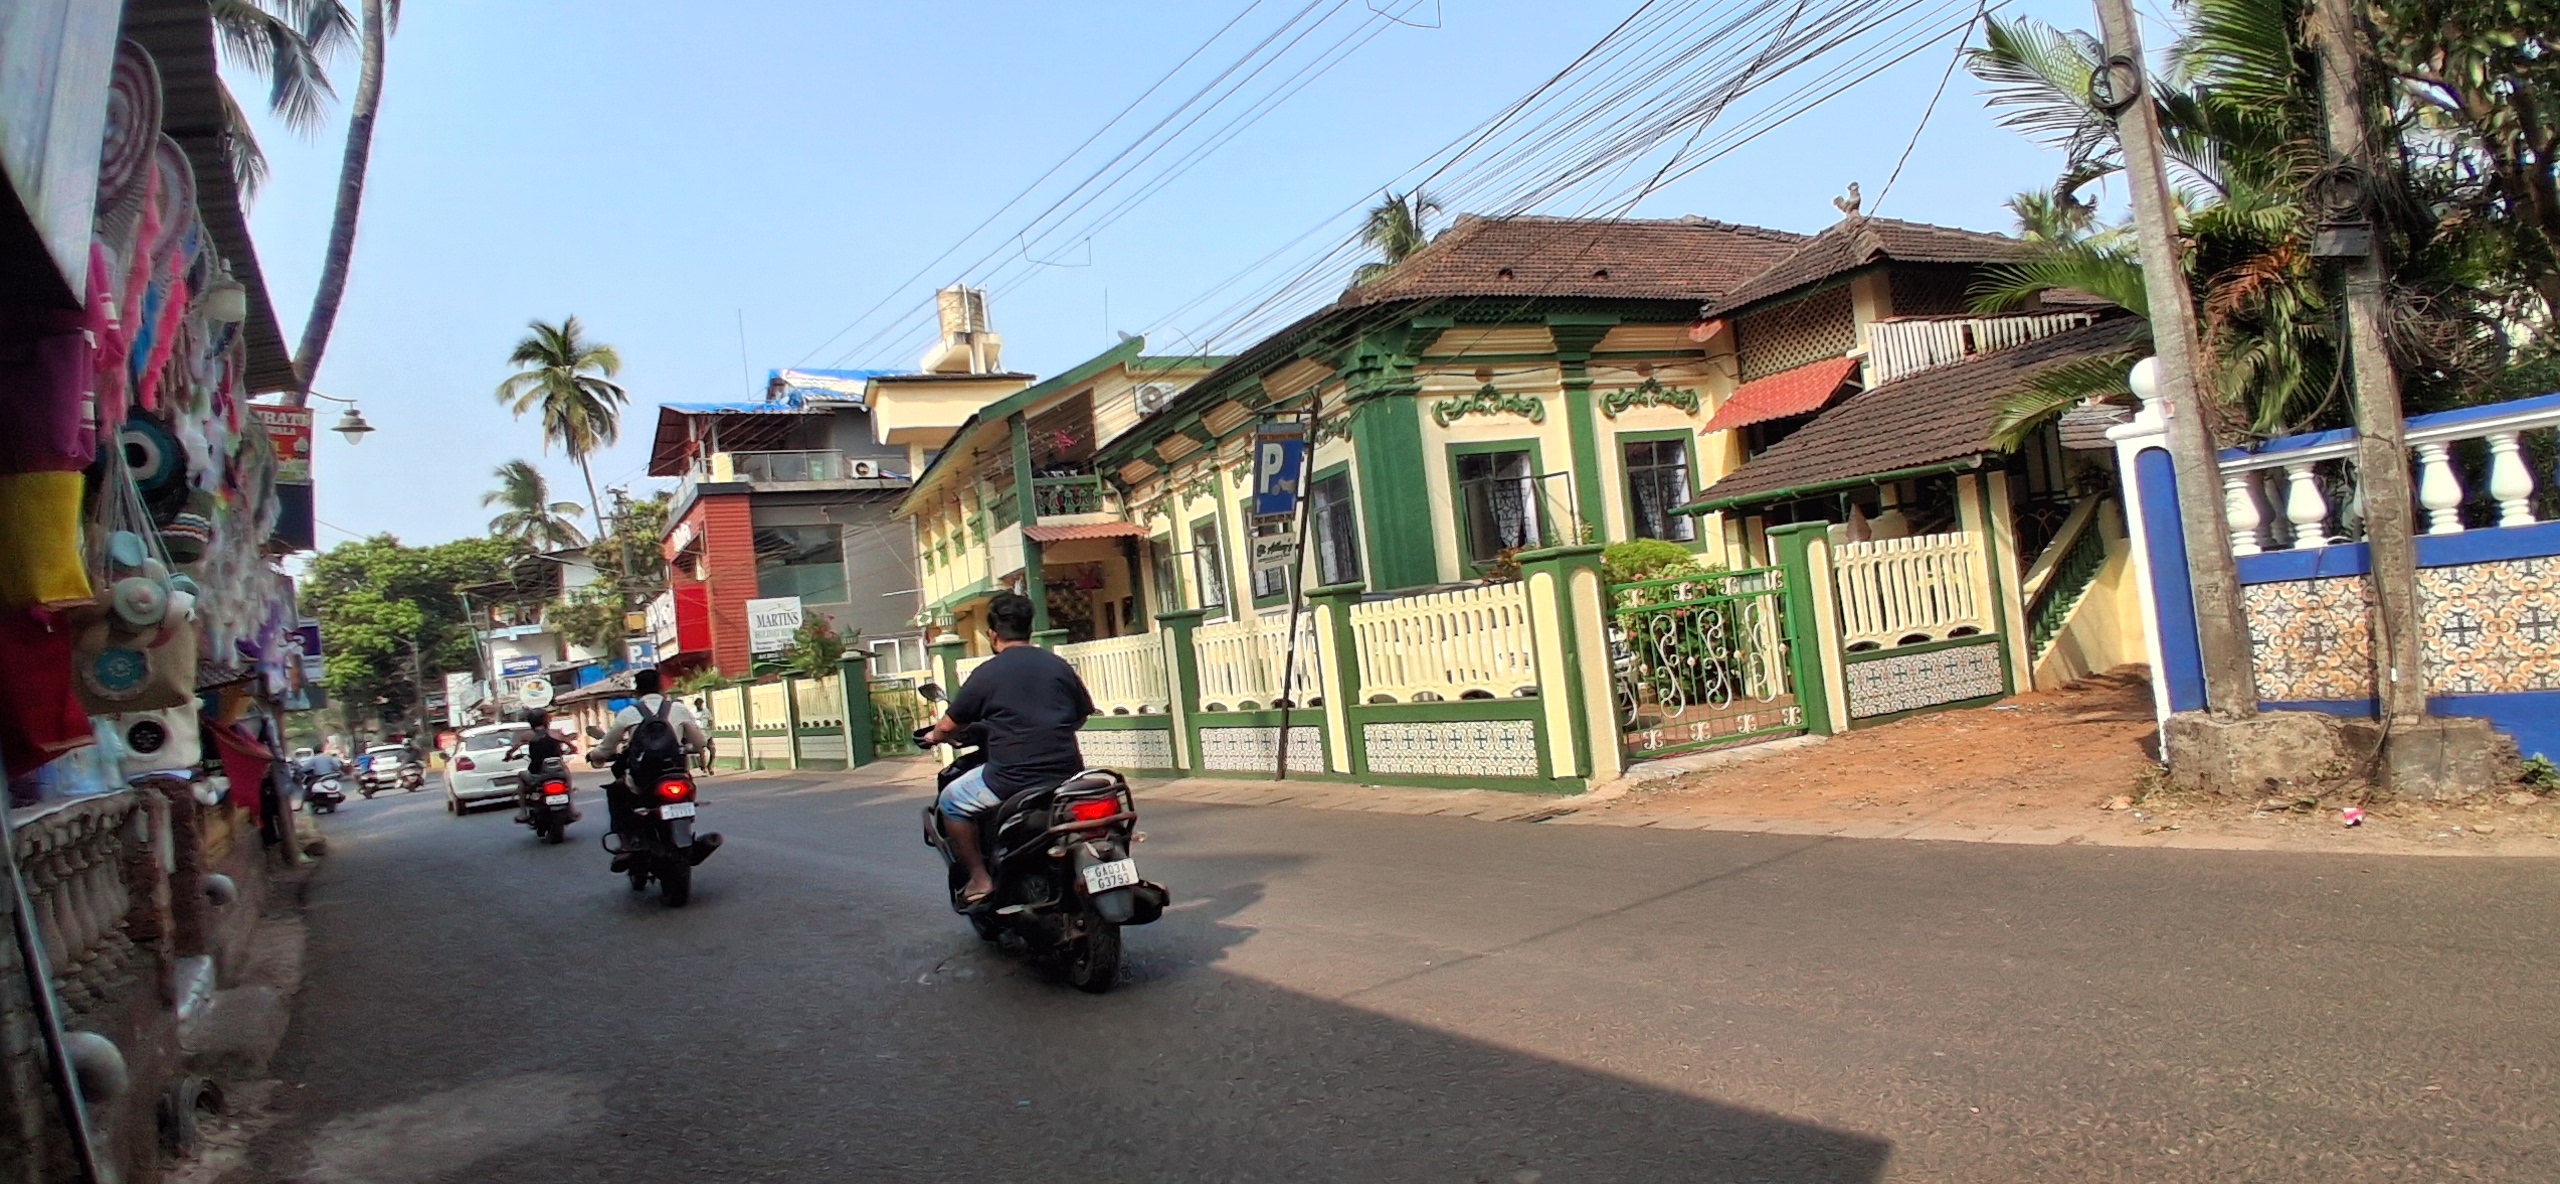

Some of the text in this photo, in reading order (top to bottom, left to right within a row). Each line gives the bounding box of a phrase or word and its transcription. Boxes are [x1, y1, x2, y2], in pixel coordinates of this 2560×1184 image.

[1260, 443, 1284, 494] P
[755, 611, 800, 629] MARTINS
[629, 644, 643, 664] P
[1095, 862, 1127, 878] GA03A
[1098, 872, 1130, 889] G3793
